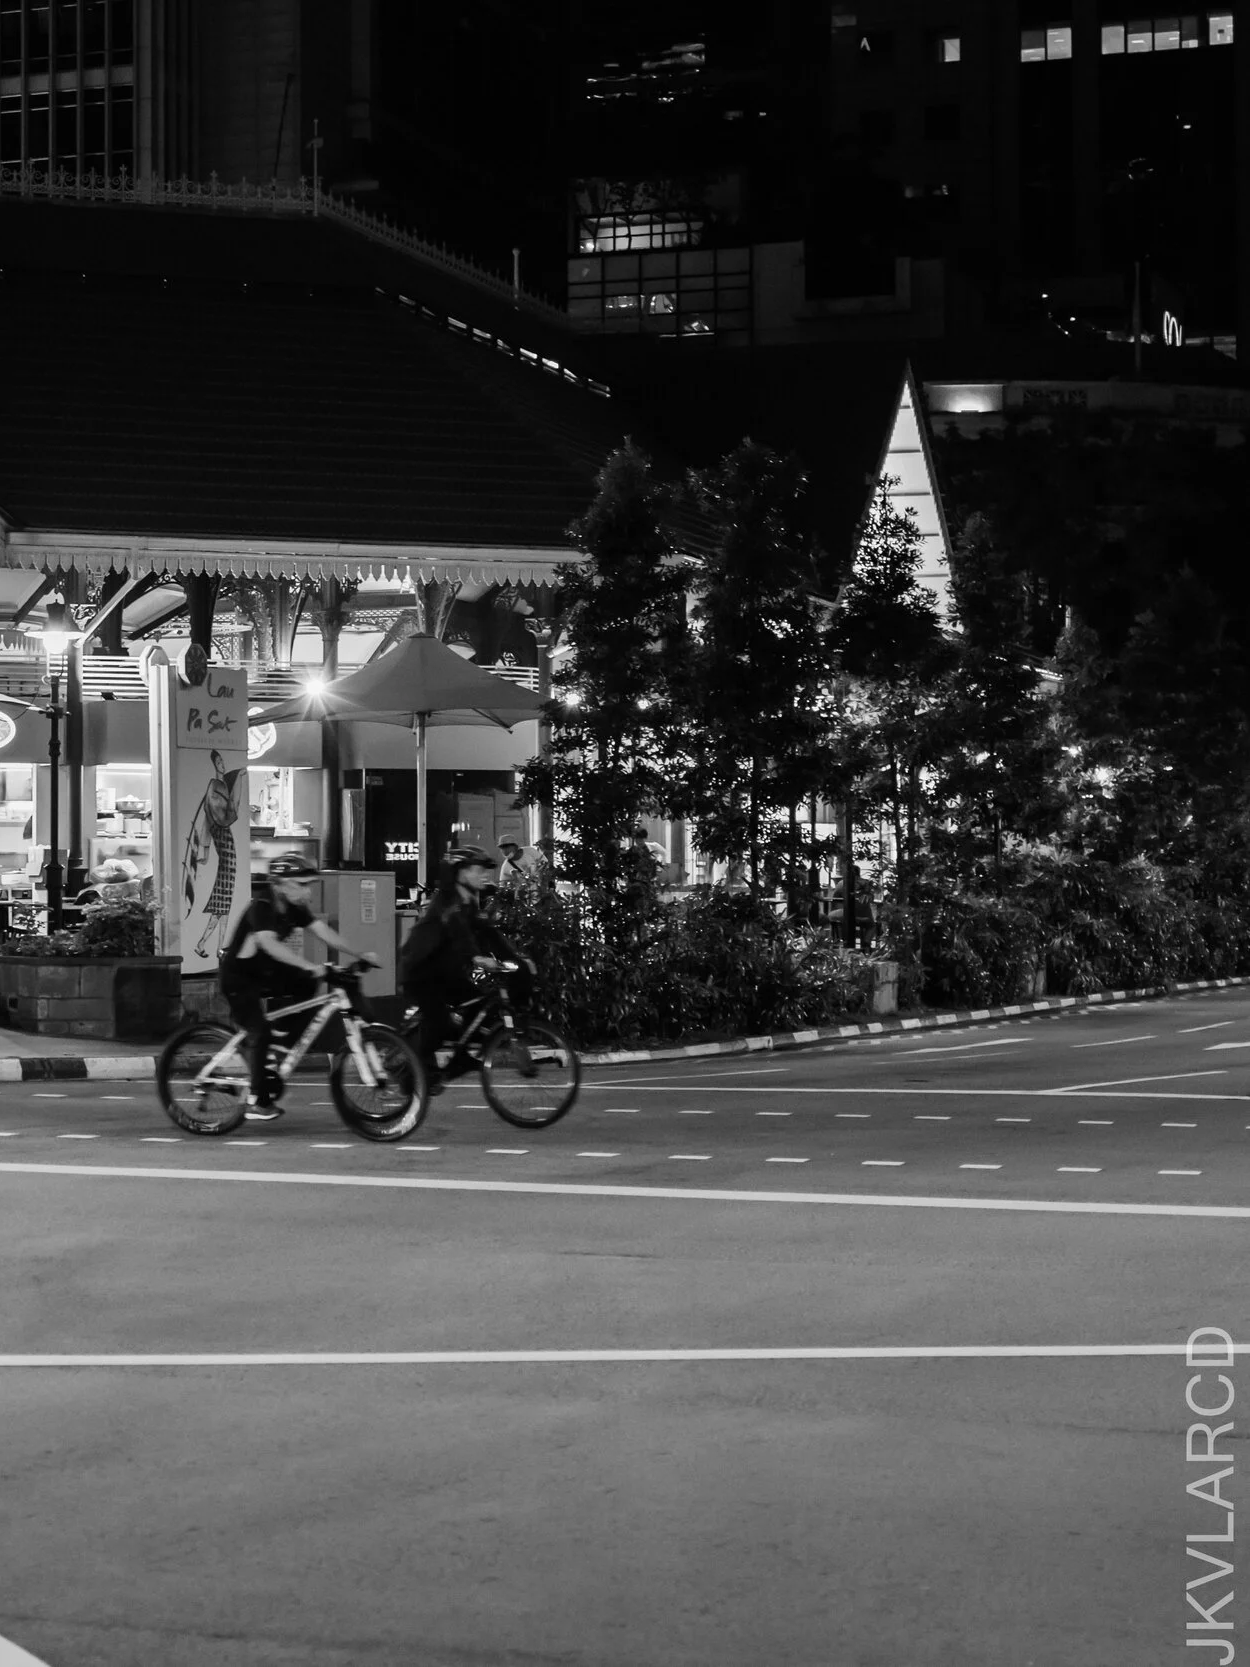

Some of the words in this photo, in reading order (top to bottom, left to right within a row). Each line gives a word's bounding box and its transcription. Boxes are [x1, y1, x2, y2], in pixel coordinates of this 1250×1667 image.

[207, 672, 235, 698] Lau
[187, 708, 202, 732] Pa
[207, 709, 238, 733] Sat
